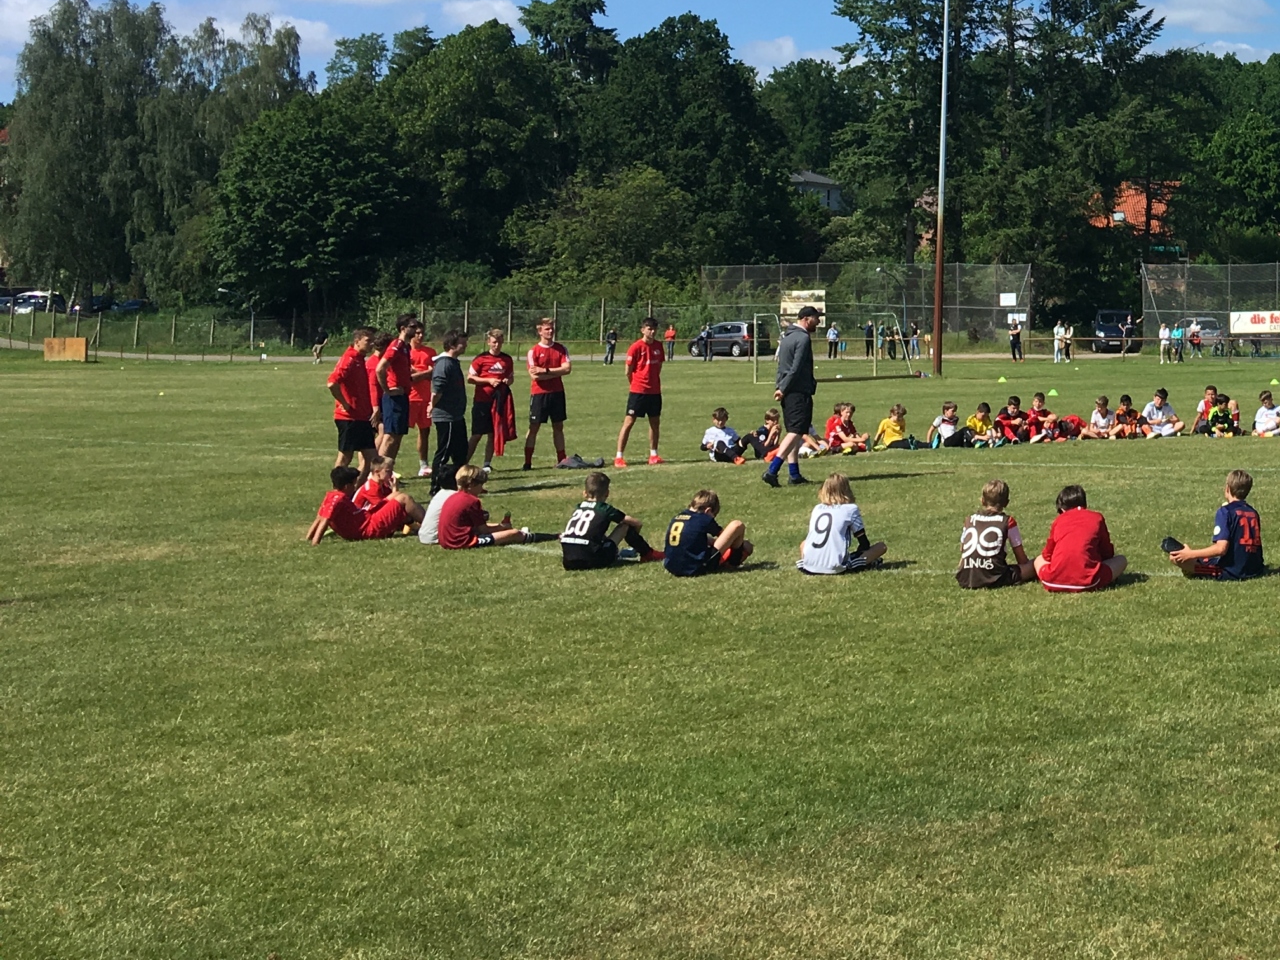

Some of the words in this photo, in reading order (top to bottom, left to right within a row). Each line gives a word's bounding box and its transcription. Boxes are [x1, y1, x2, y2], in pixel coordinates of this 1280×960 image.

[1250, 314, 1266, 324] die
[560, 509, 595, 538] 28
[669, 521, 685, 546] 8
[811, 512, 833, 549] 9
[1239, 517, 1261, 545] 11
[961, 526, 1003, 559] 99
[963, 557, 994, 570] LINUS
